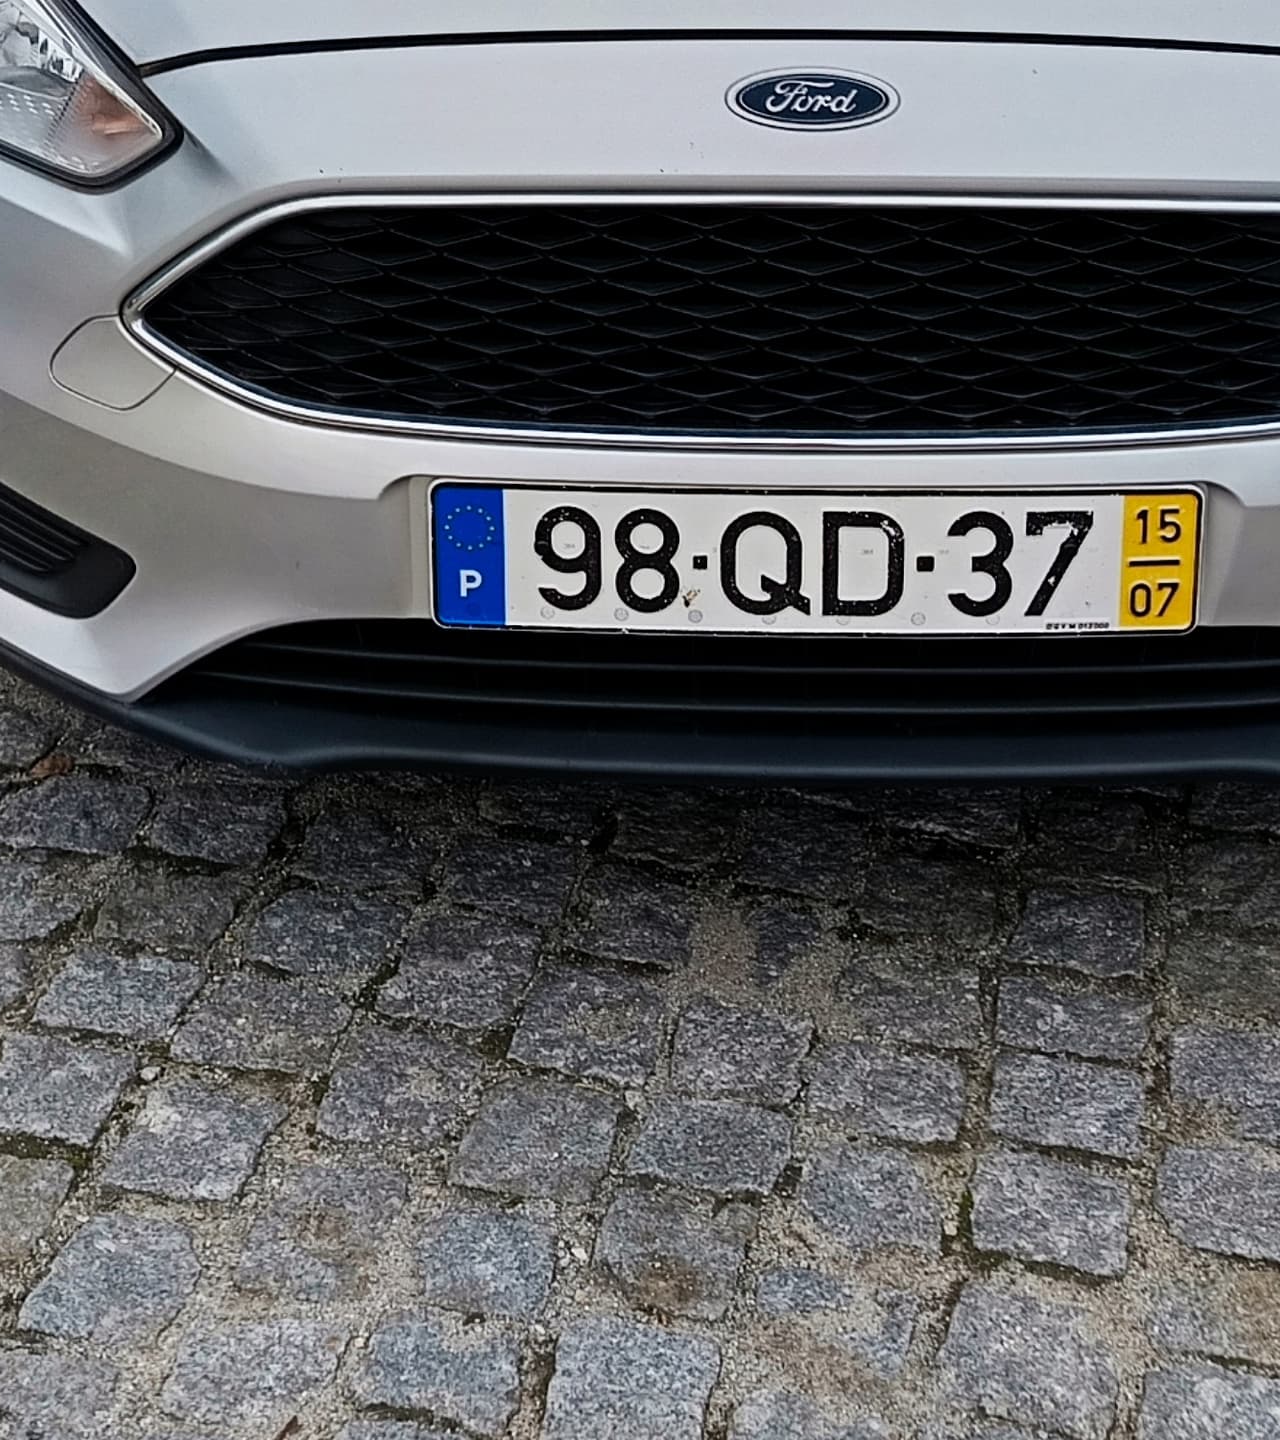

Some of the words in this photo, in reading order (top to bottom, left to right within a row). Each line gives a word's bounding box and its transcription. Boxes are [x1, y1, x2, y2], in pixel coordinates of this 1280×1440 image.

[765, 80, 858, 113] Ford
[1136, 508, 1182, 544] 15
[460, 570, 482, 597] P
[1129, 582, 1180, 617] 07
